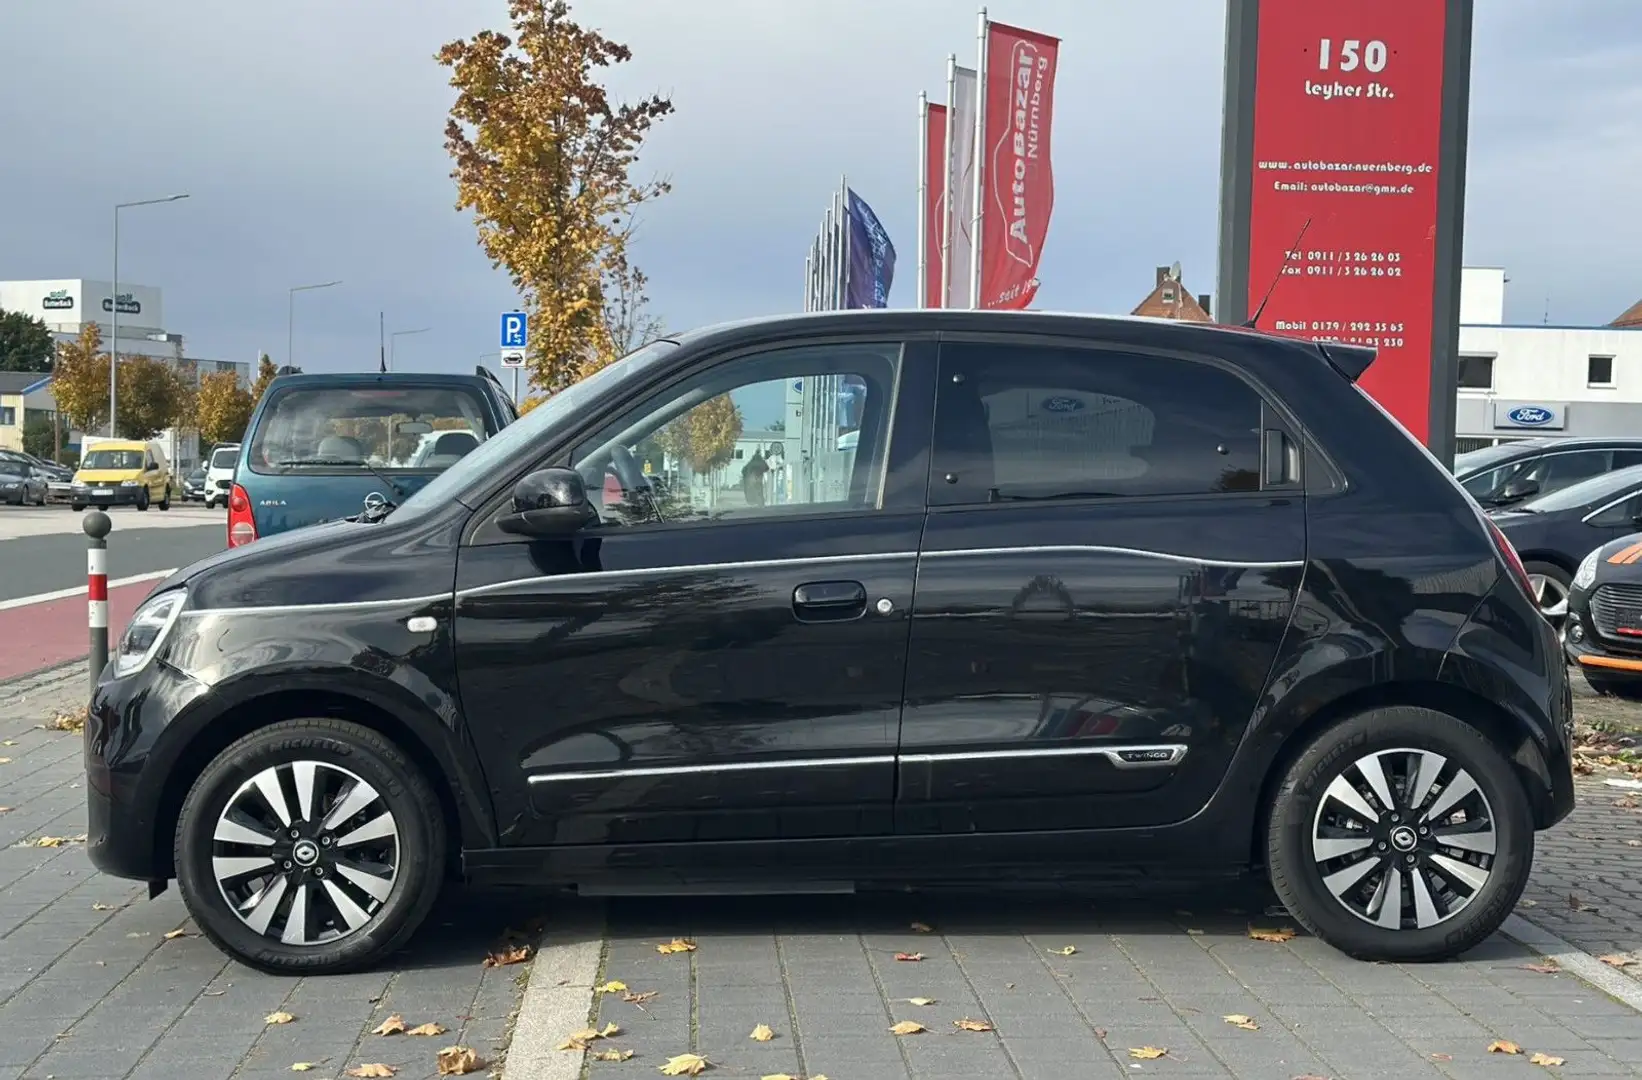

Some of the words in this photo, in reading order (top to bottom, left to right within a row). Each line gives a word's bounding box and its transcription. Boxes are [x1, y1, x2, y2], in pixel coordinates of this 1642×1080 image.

[1319, 38, 1387, 73] 150
[1305, 80, 1362, 100] Leyher
[1366, 83, 1395, 99] Str.
[1028, 56, 1048, 158] Nürnberg
[1010, 49, 1034, 243] AutoBazar
[1258, 160, 1433, 175] www.autobazar-nuernberg.de
[1274, 180, 1308, 192] Email:
[1311, 182, 1414, 196] autobazar@gmx.de
[1285, 251, 1301, 260] Tel
[1307, 251, 1334, 261] 0911
[1307, 266, 1333, 276] 0911
[1275, 321, 1306, 330] Mobil
[1312, 321, 1339, 330] 0179
[1516, 409, 1546, 421] Ford
